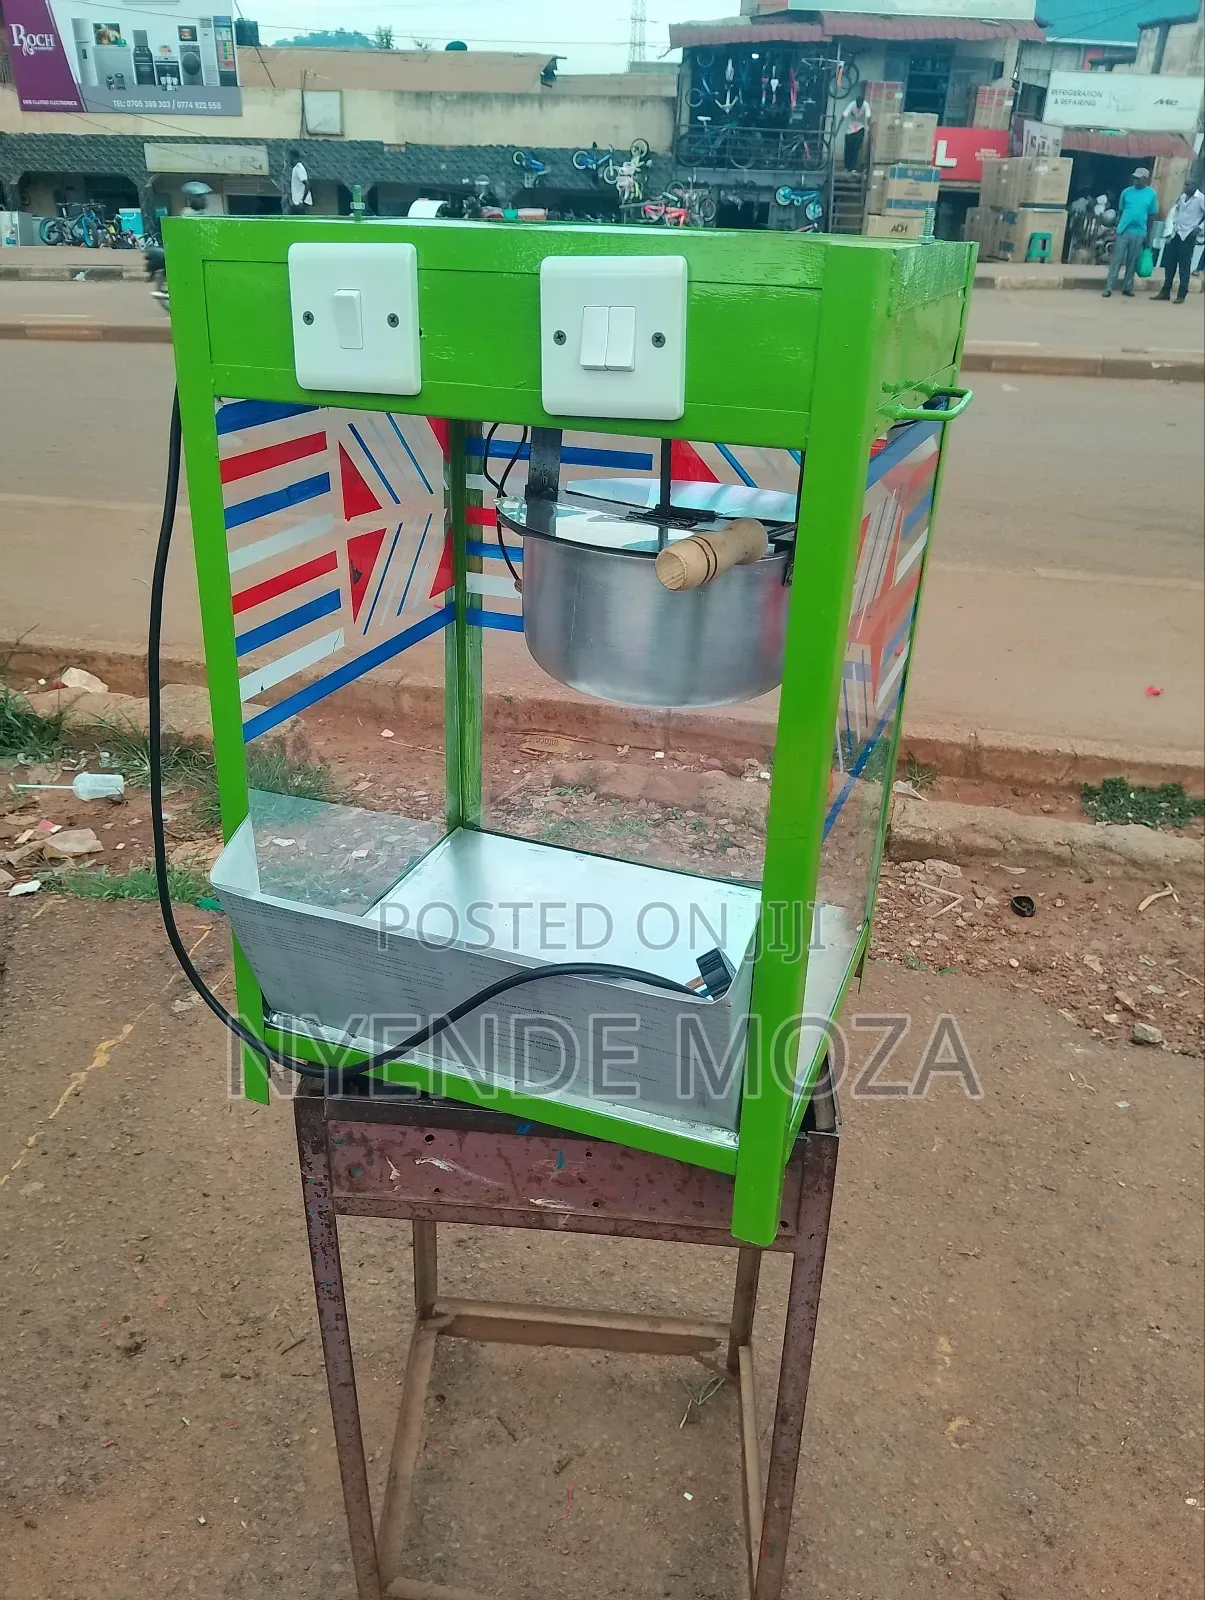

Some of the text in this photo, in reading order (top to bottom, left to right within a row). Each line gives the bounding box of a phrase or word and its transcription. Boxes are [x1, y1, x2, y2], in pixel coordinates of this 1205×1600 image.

[1050, 88, 1103, 98] REFRIGERATION
[112, 99, 126, 107] TEL:
[1061, 99, 1096, 107] REPAIRING
